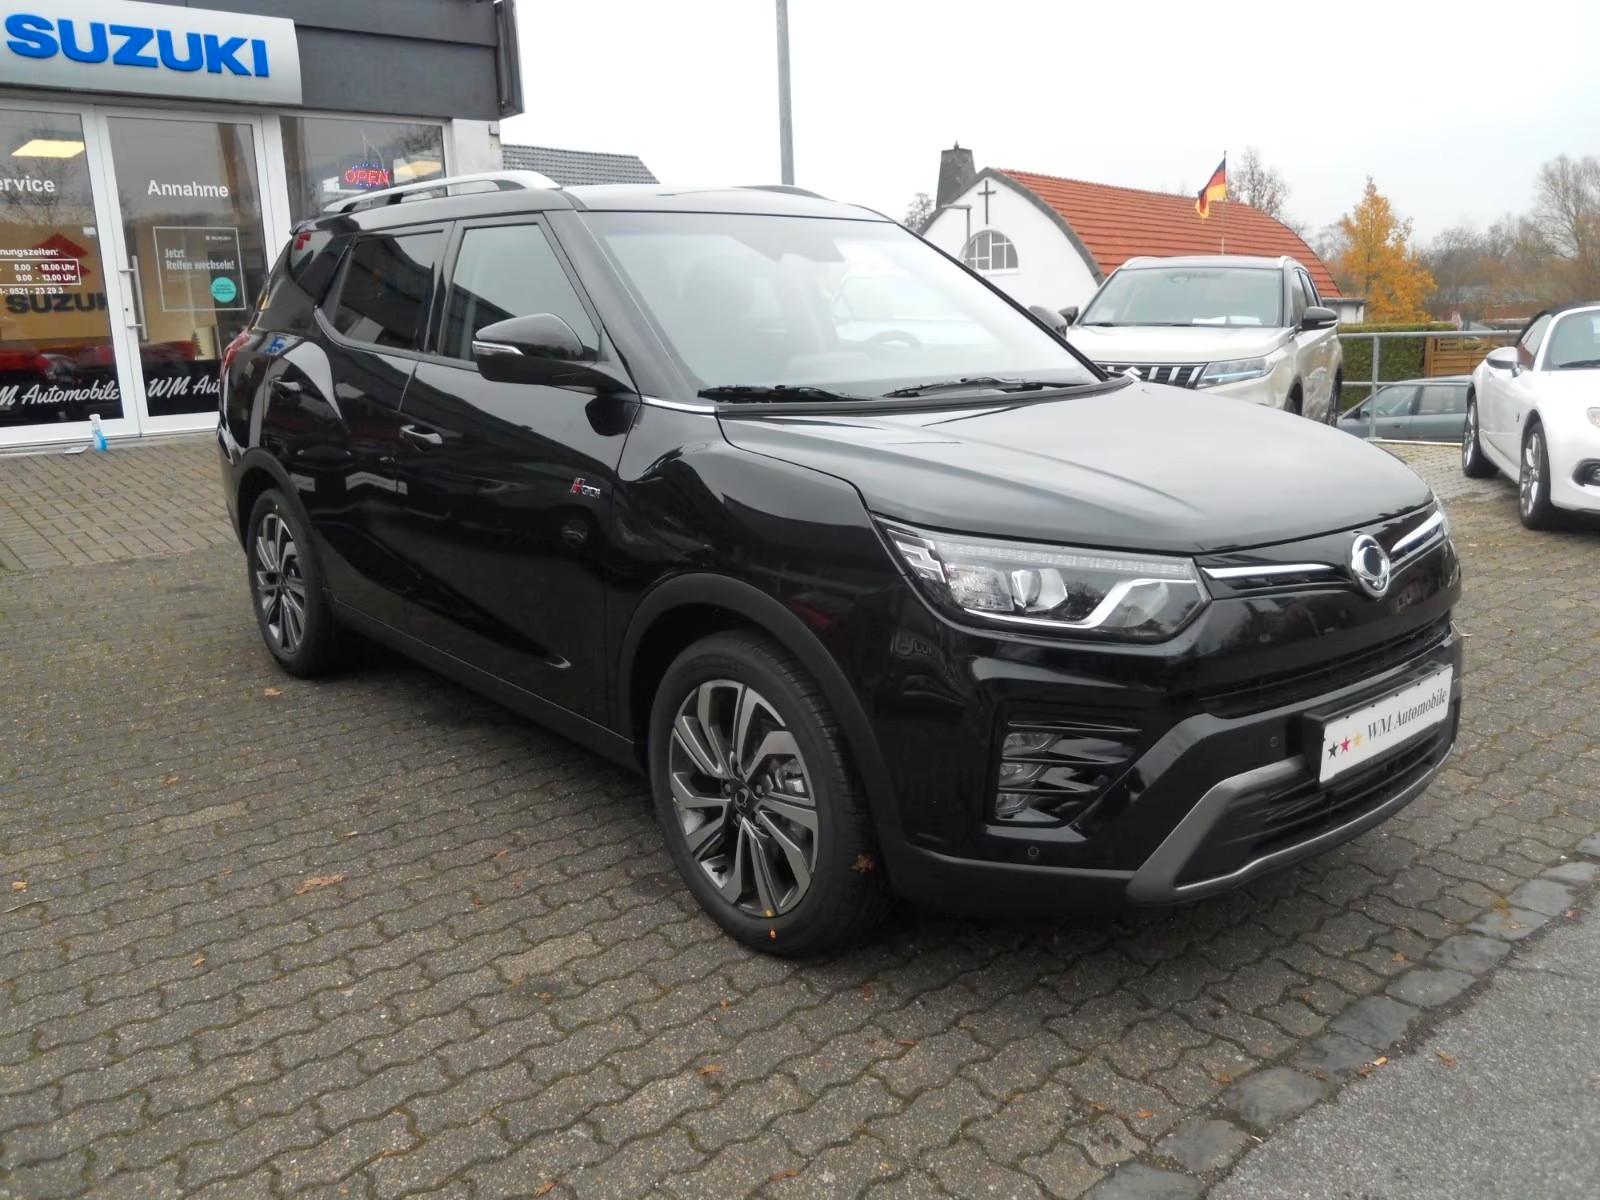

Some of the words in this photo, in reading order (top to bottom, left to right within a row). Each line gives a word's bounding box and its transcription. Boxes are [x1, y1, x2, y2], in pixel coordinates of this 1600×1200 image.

[5, 14, 269, 78] SUZUKI
[345, 169, 390, 185] OPEN
[147, 180, 229, 198] Annahme
[165, 249, 185, 258] Jetzt
[61, 263, 75, 271] Uhr
[166, 260, 193, 270] Reifen
[194, 260, 235, 270] wechseln!
[9, 287, 29, 295] 0521
[22, 379, 120, 405] Automobile
[148, 376, 189, 398] WM
[1367, 714, 1392, 741] WM
[1394, 687, 1447, 728] Automobile
